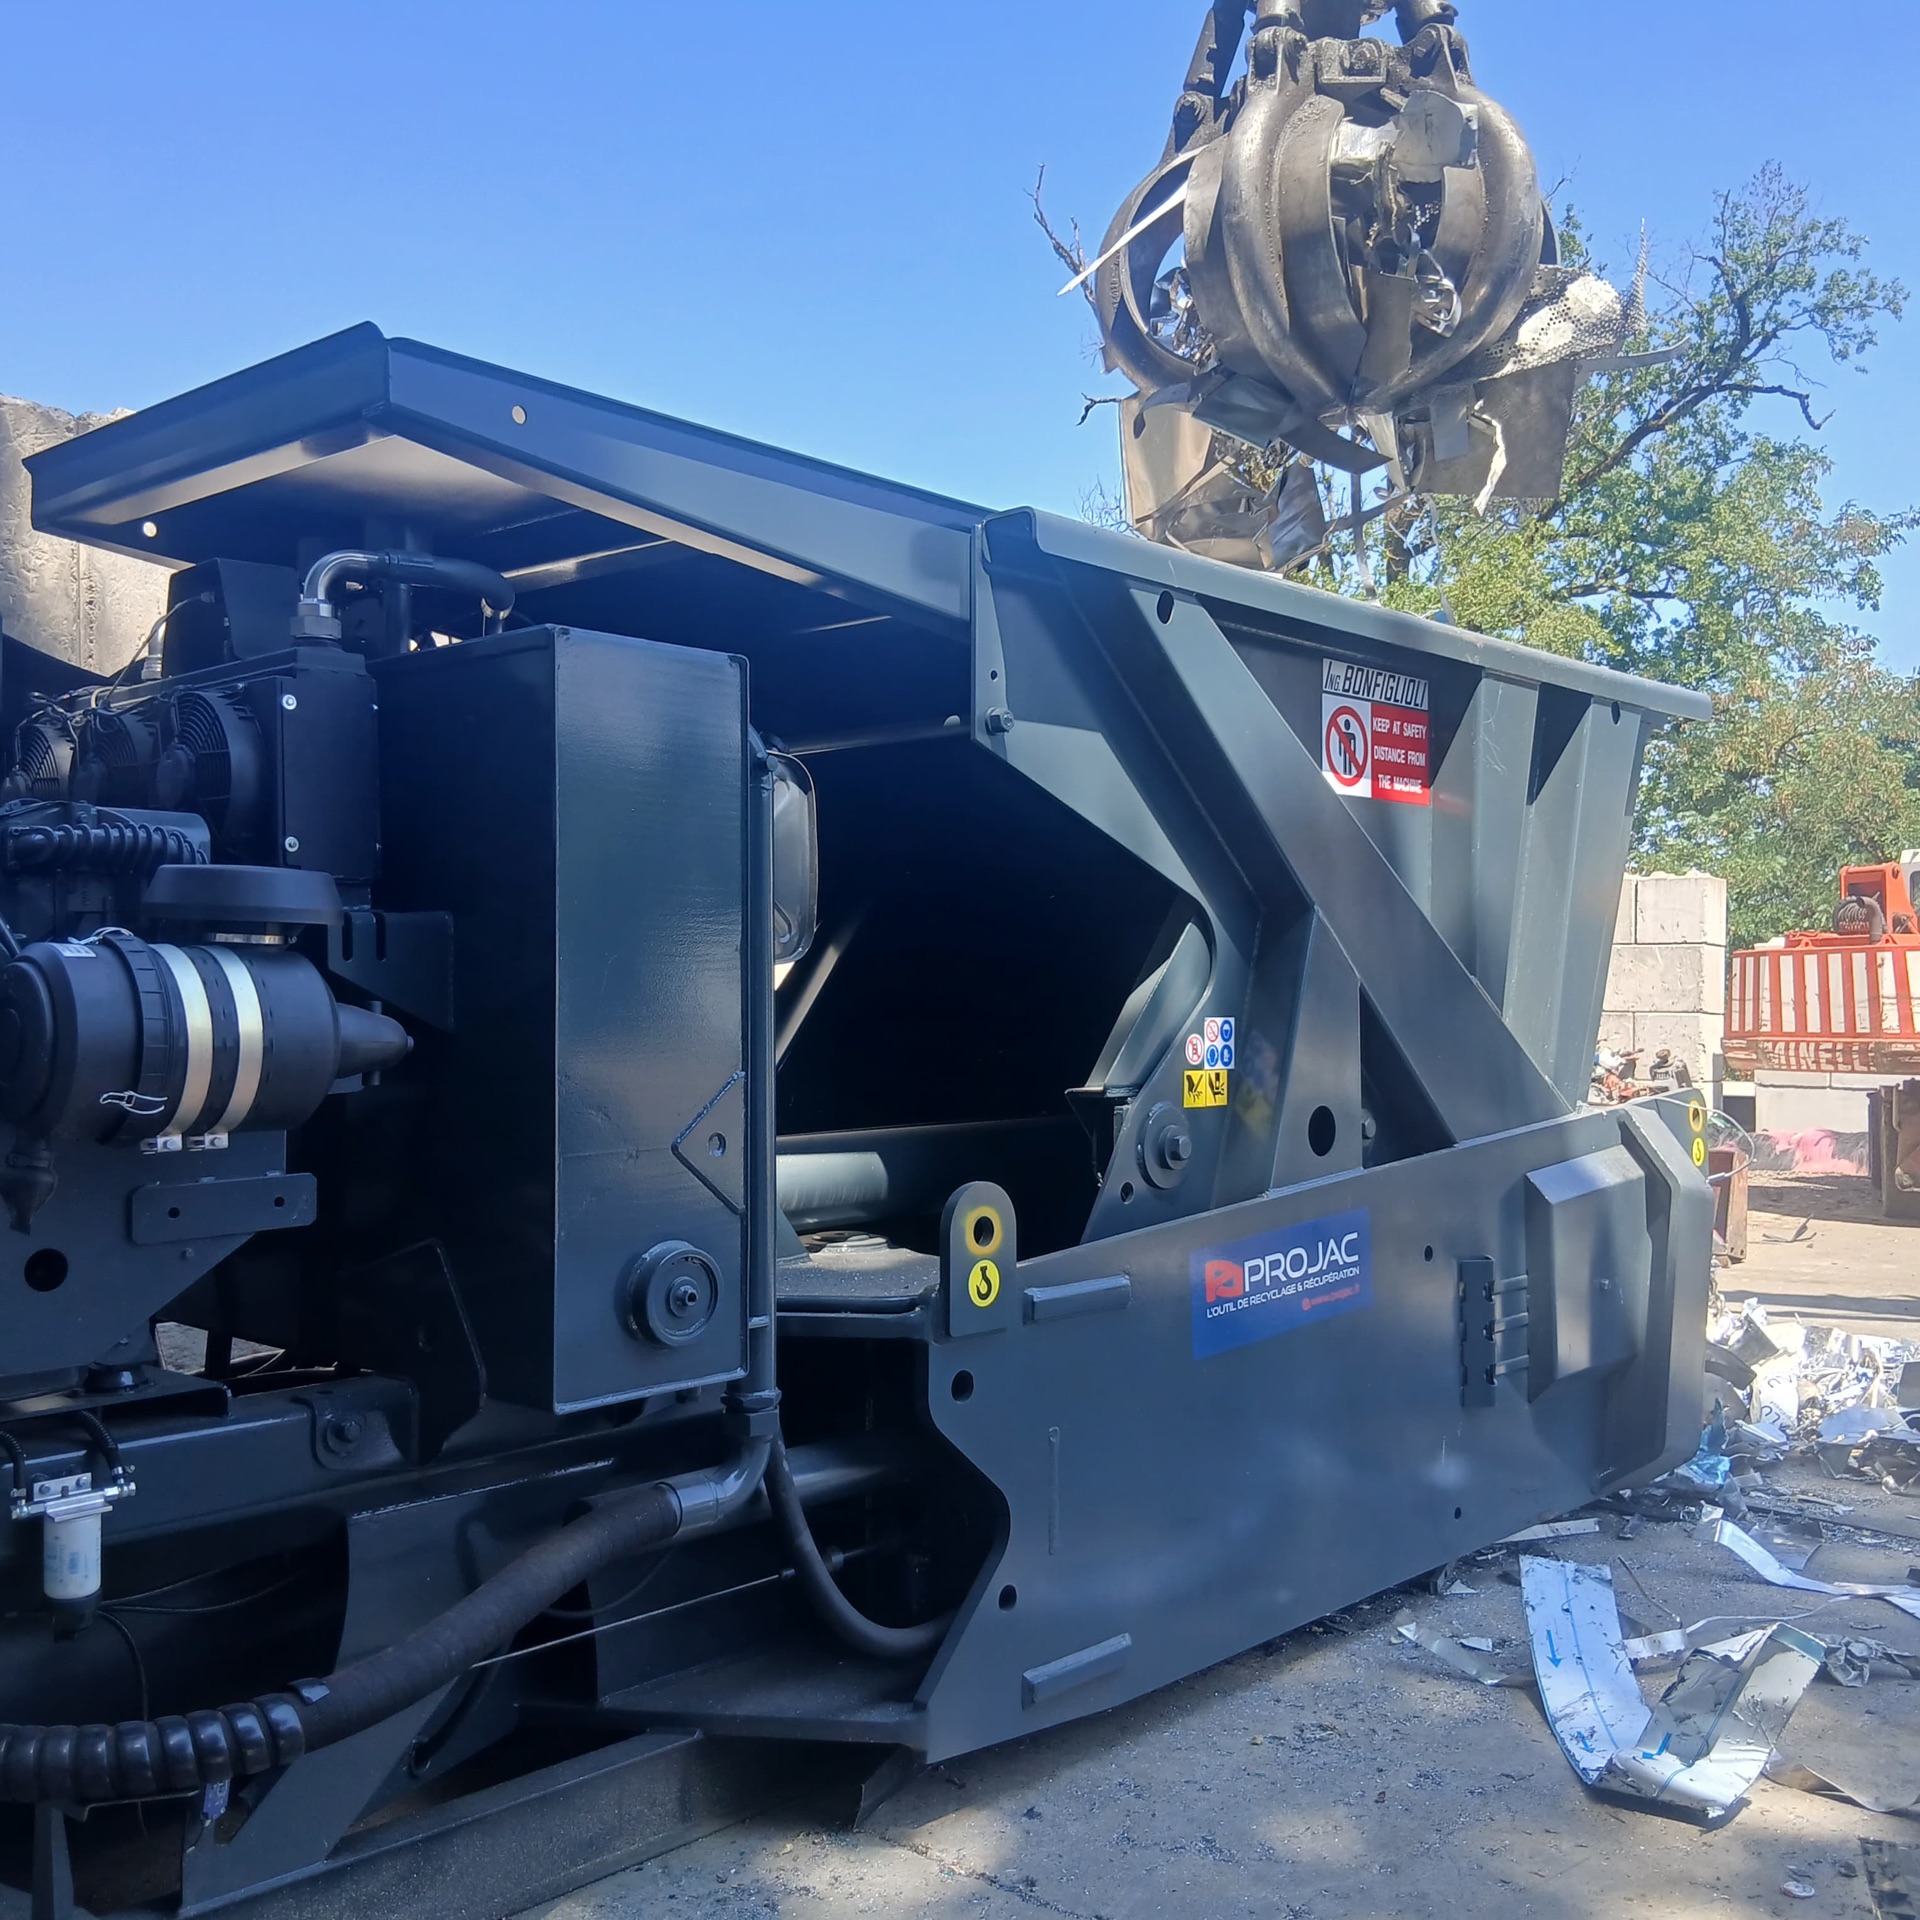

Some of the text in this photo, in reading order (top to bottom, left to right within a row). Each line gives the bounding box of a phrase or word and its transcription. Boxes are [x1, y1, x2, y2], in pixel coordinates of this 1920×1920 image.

[1342, 665, 1428, 708] BONFIGLIOLI
[1373, 717, 1427, 739] KEEP AT SAFETY
[1374, 746, 1426, 766] DISTANCE FROM
[1378, 774, 1422, 793] THE MACHINE
[1244, 1232, 1359, 1292] PROJAC
[1206, 1302, 1237, 1318] L'OUTIL
[1237, 1297, 1249, 1309] DE
[1250, 1283, 1297, 1306] RECYCLAGE
[1297, 1282, 1303, 1292] &
[1304, 1266, 1360, 1290] RÉCUPÉRATION
